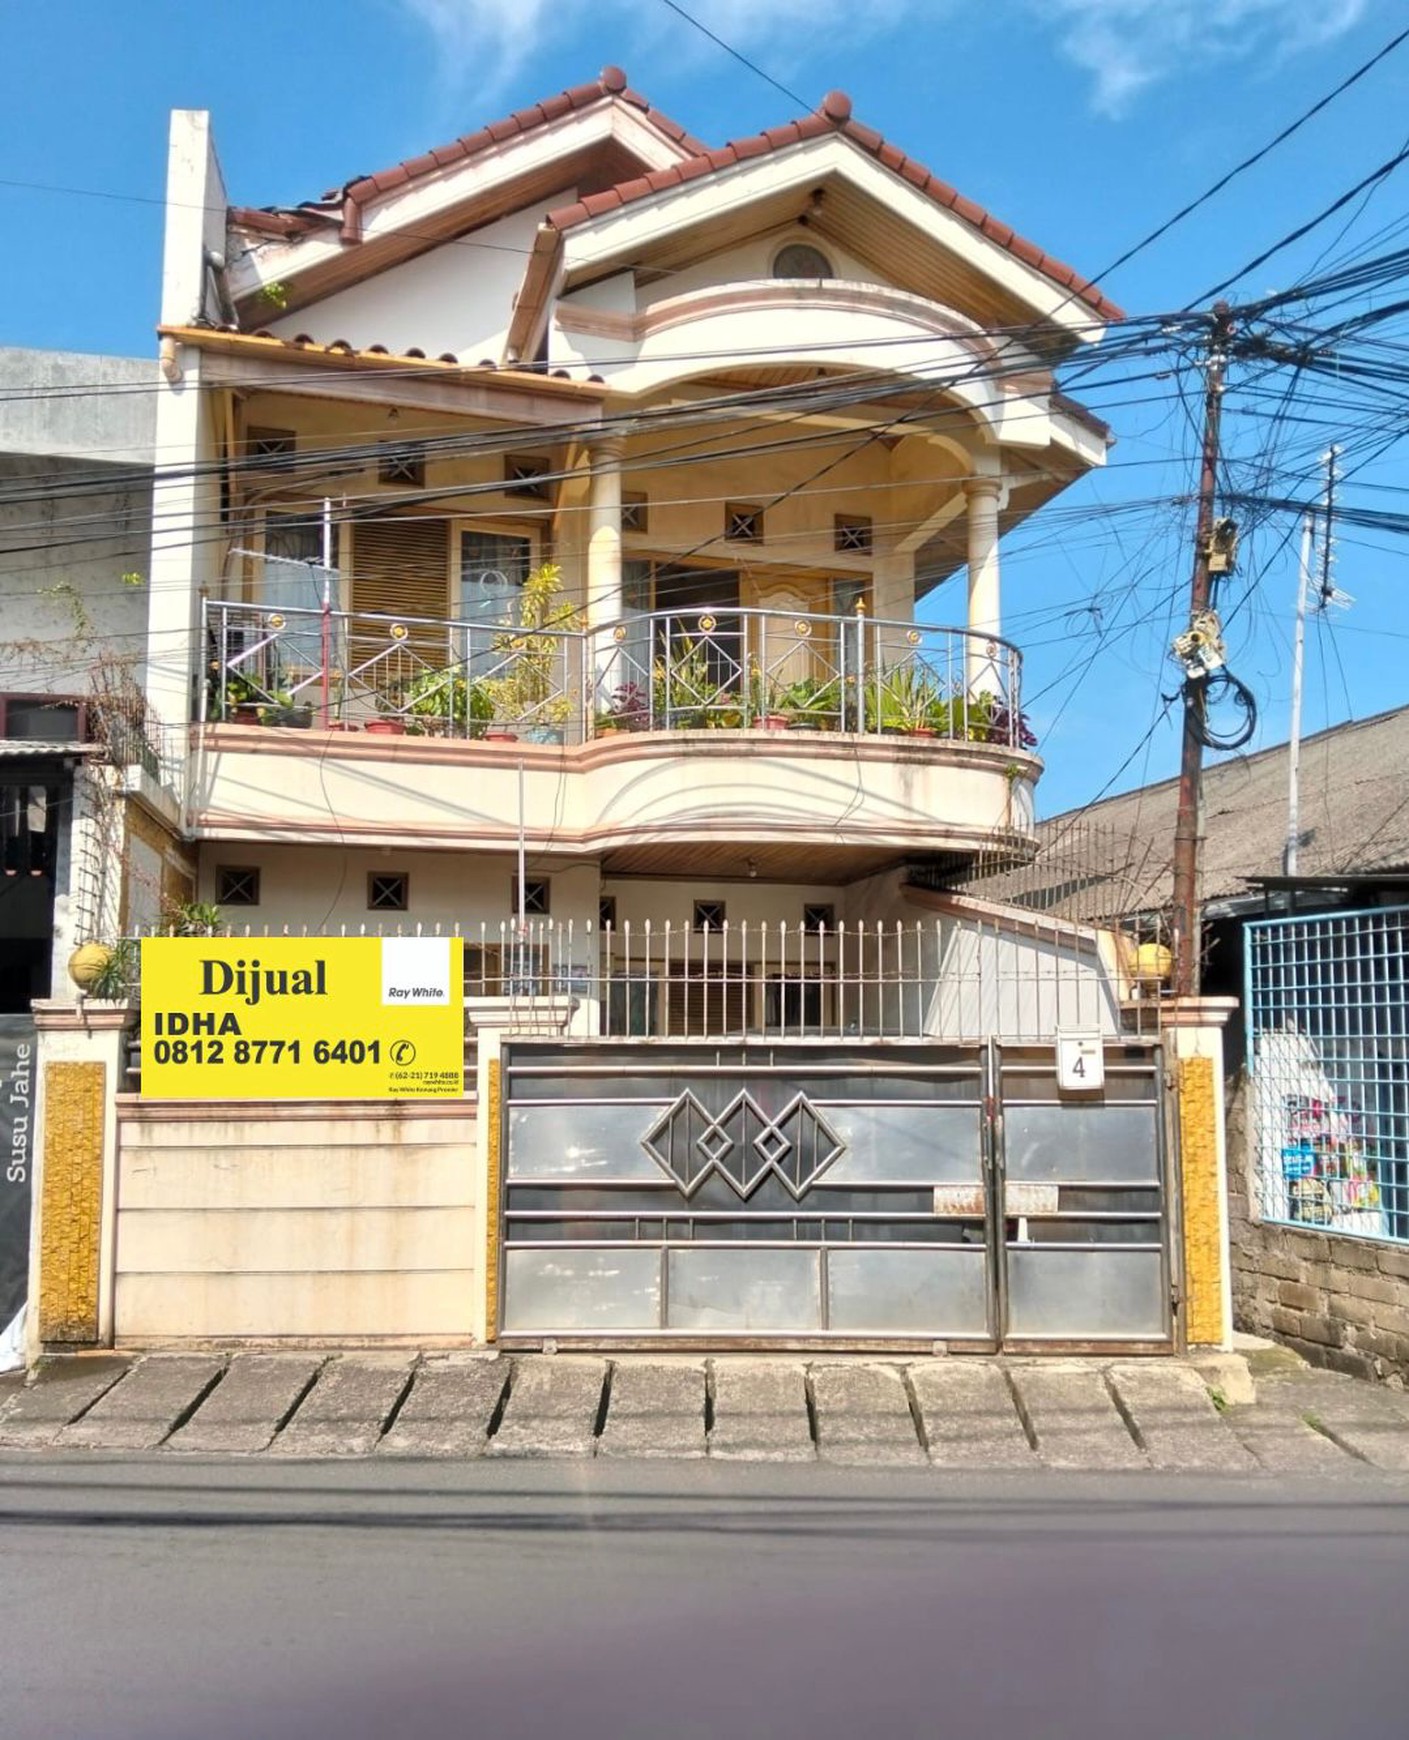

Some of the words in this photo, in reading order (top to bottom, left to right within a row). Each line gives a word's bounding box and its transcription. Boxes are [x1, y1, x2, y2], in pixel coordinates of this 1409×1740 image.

[200, 959, 328, 1006] Dijual
[388, 987, 411, 999] Ray
[154, 1012, 242, 1036] IDHA
[154, 1039, 224, 1065] 0812
[233, 1039, 300, 1065] 8771
[314, 1039, 380, 1065] 6401
[9, 1043, 31, 1108] Jahe
[424, 1071, 439, 1079] 719
[1072, 1056, 1086, 1078] 4
[6, 1116, 29, 1183] Susu
